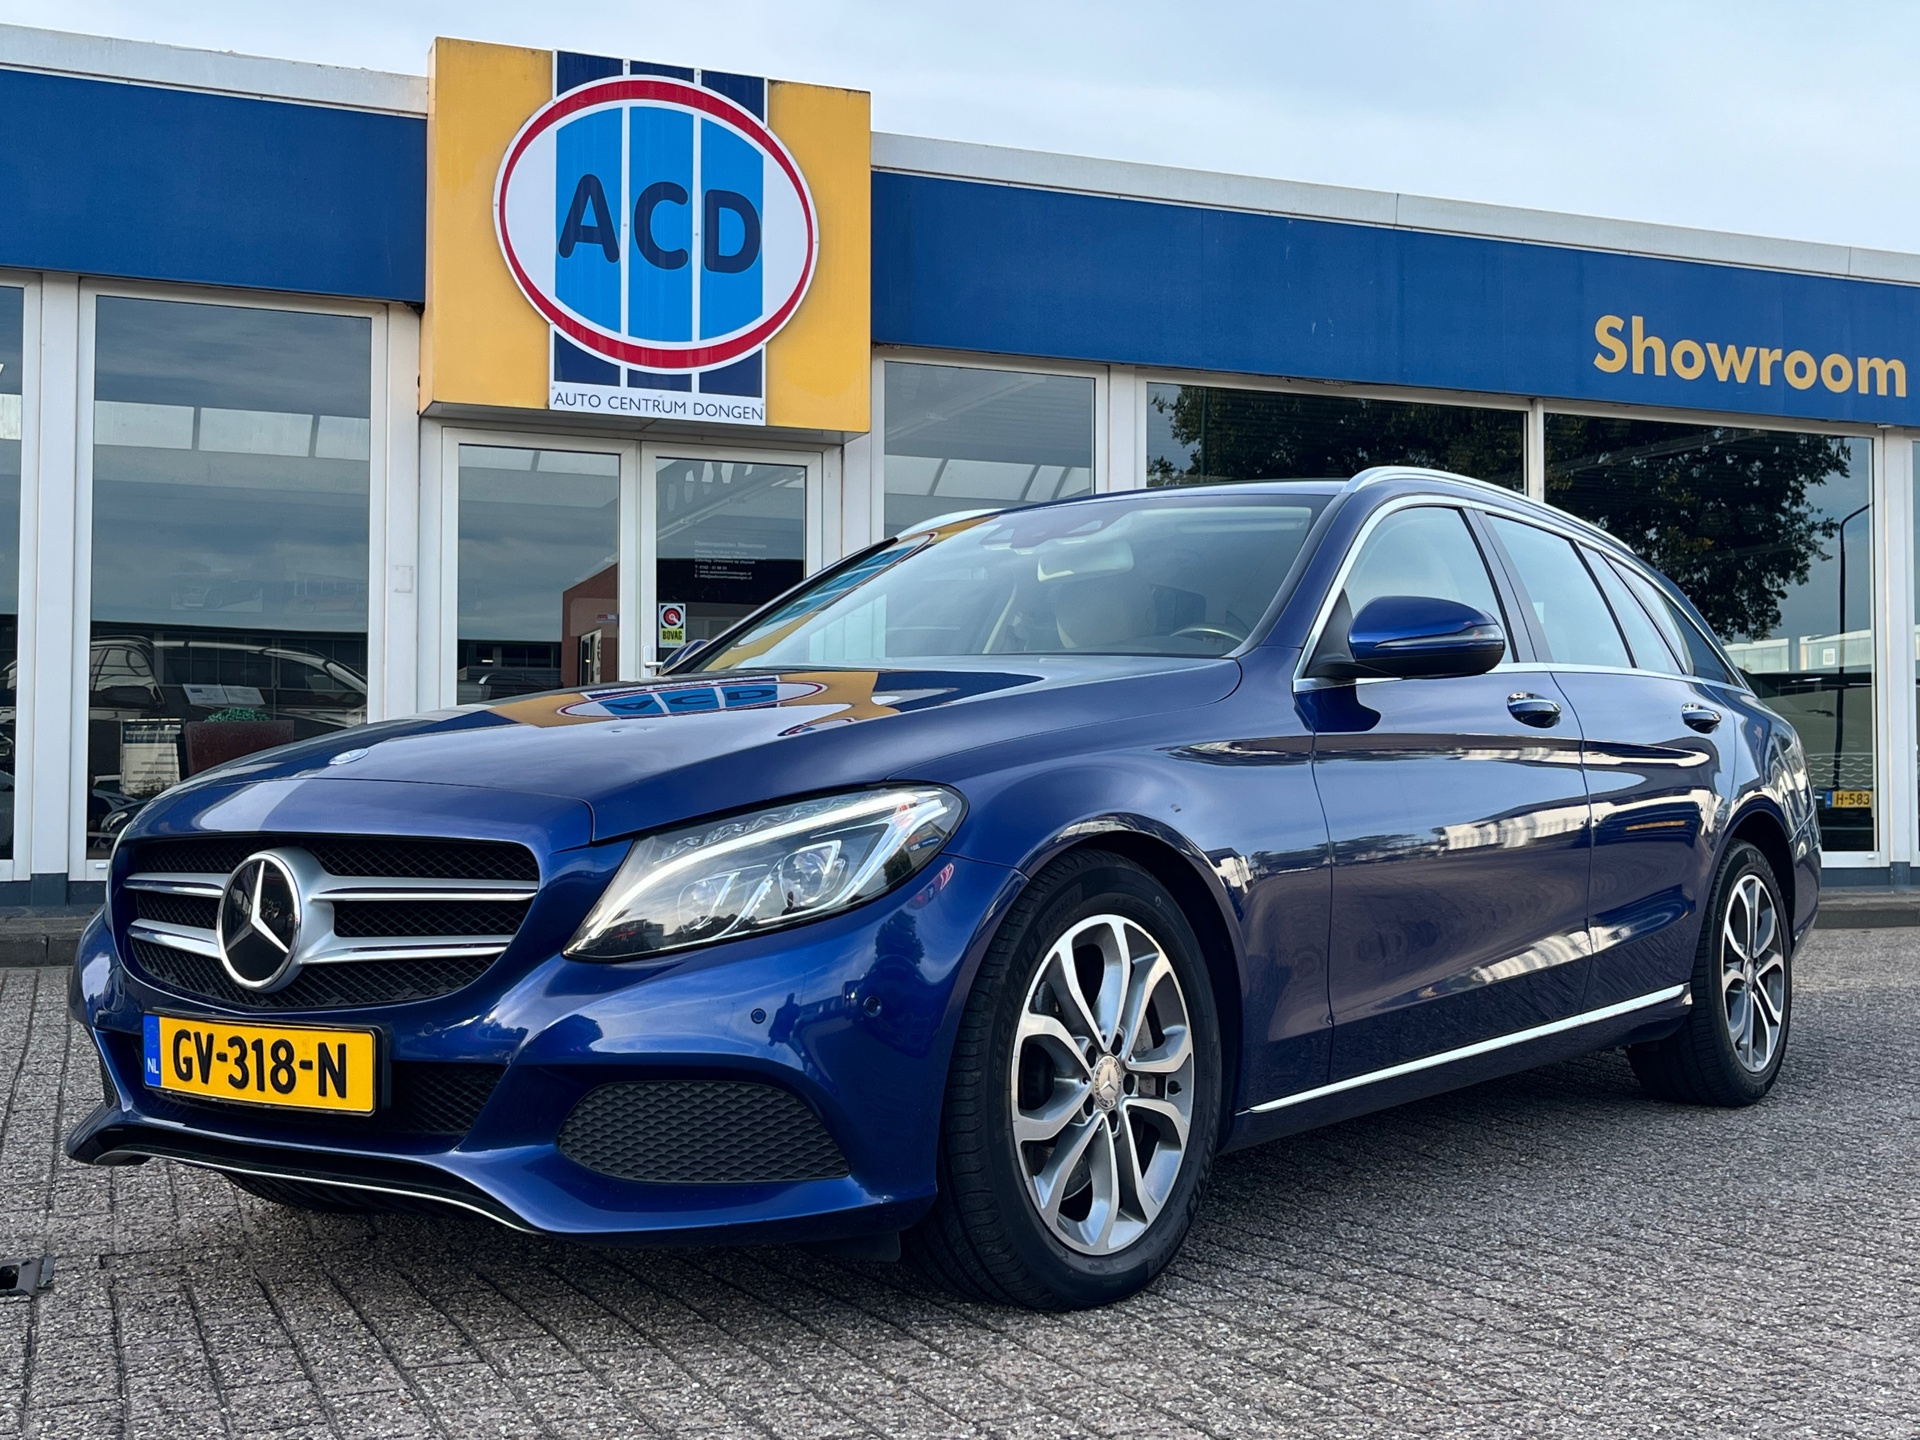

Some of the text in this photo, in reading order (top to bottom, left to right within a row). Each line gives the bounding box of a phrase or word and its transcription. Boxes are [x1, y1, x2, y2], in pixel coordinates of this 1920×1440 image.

[558, 173, 761, 274] ACD
[1593, 314, 1907, 398] Showroom
[553, 391, 764, 421] AUTO CENTRUM DONGEN
[662, 630, 682, 641] BOVAG
[146, 1057, 160, 1075] NL
[172, 1028, 347, 1099] GV-318-N
